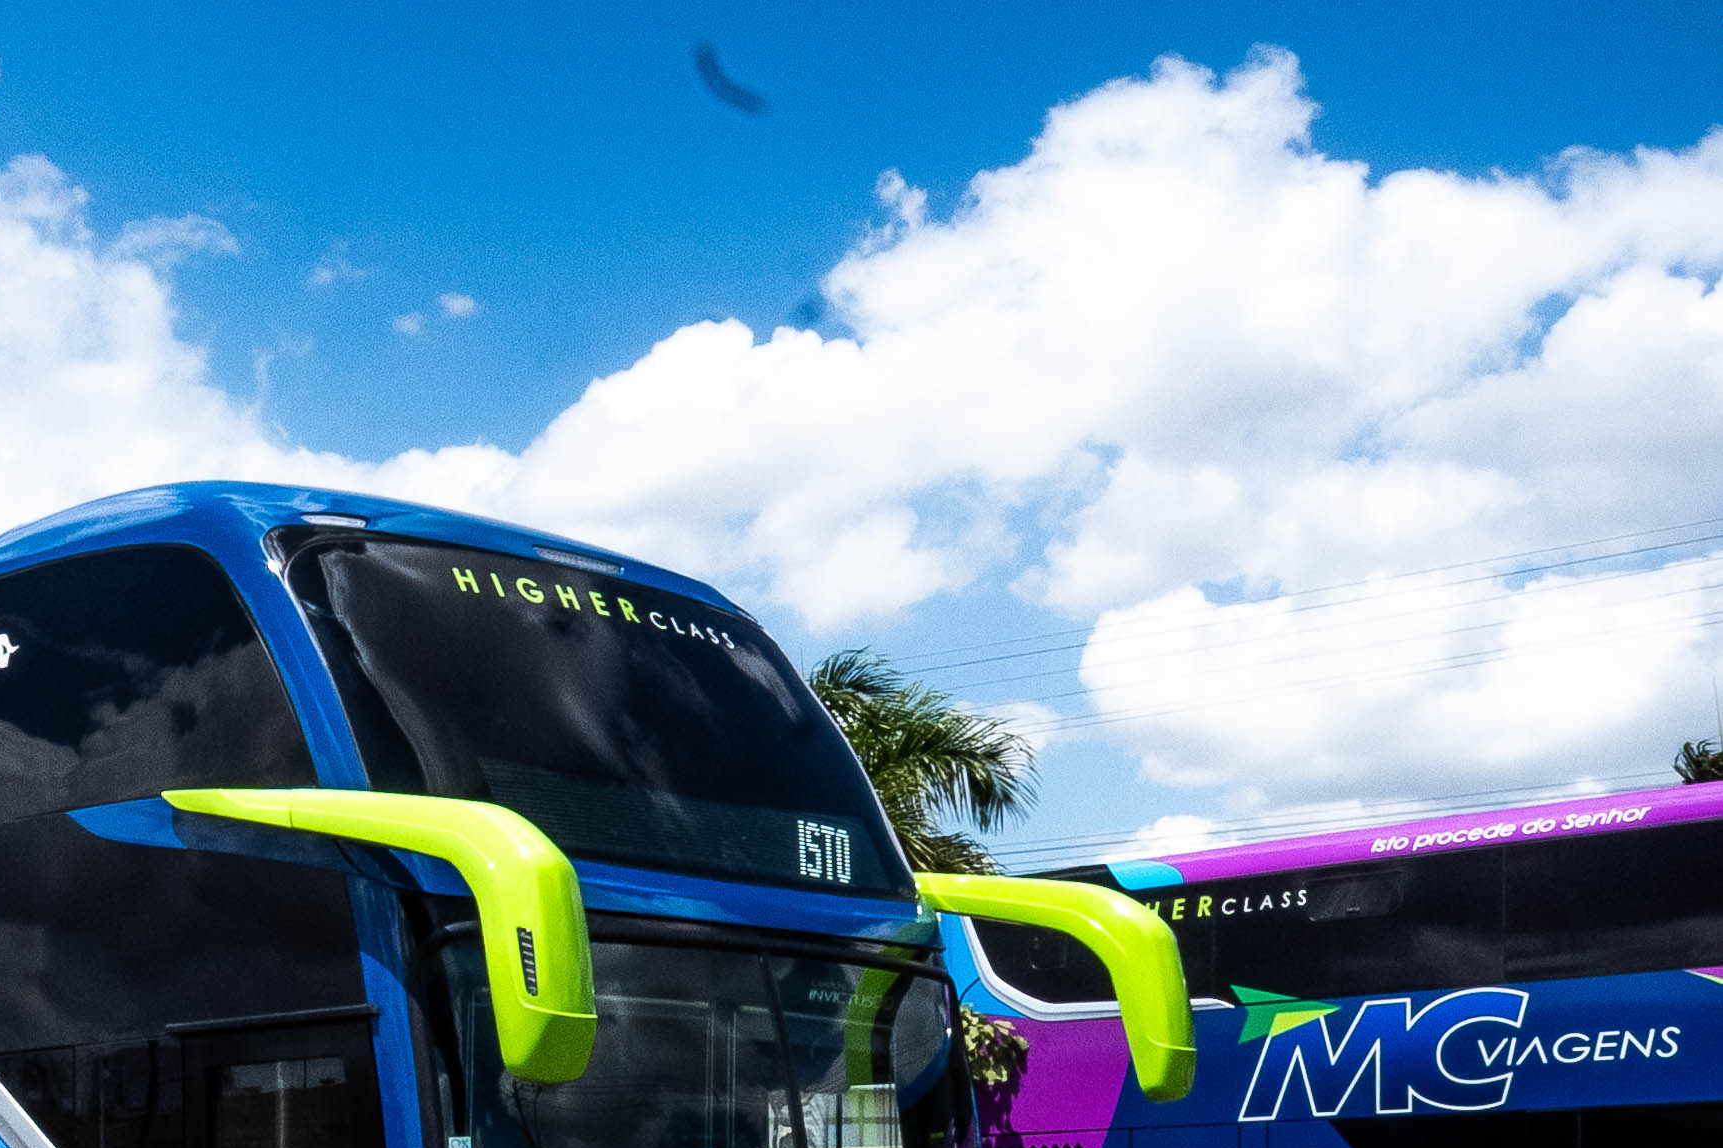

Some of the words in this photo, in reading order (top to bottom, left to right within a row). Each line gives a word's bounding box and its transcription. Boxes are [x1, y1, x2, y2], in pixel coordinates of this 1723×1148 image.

[451, 567, 640, 623] HIGHER
[649, 611, 735, 650] CLASS
[1370, 835, 1410, 853] Isto
[1412, 822, 1517, 852] procede
[1521, 816, 1556, 837] do
[1561, 805, 1652, 831] Senhor
[1221, 889, 1308, 916] CLASS
[1238, 986, 1530, 1122] MC
[1478, 1025, 1682, 1068] VIAGENS
